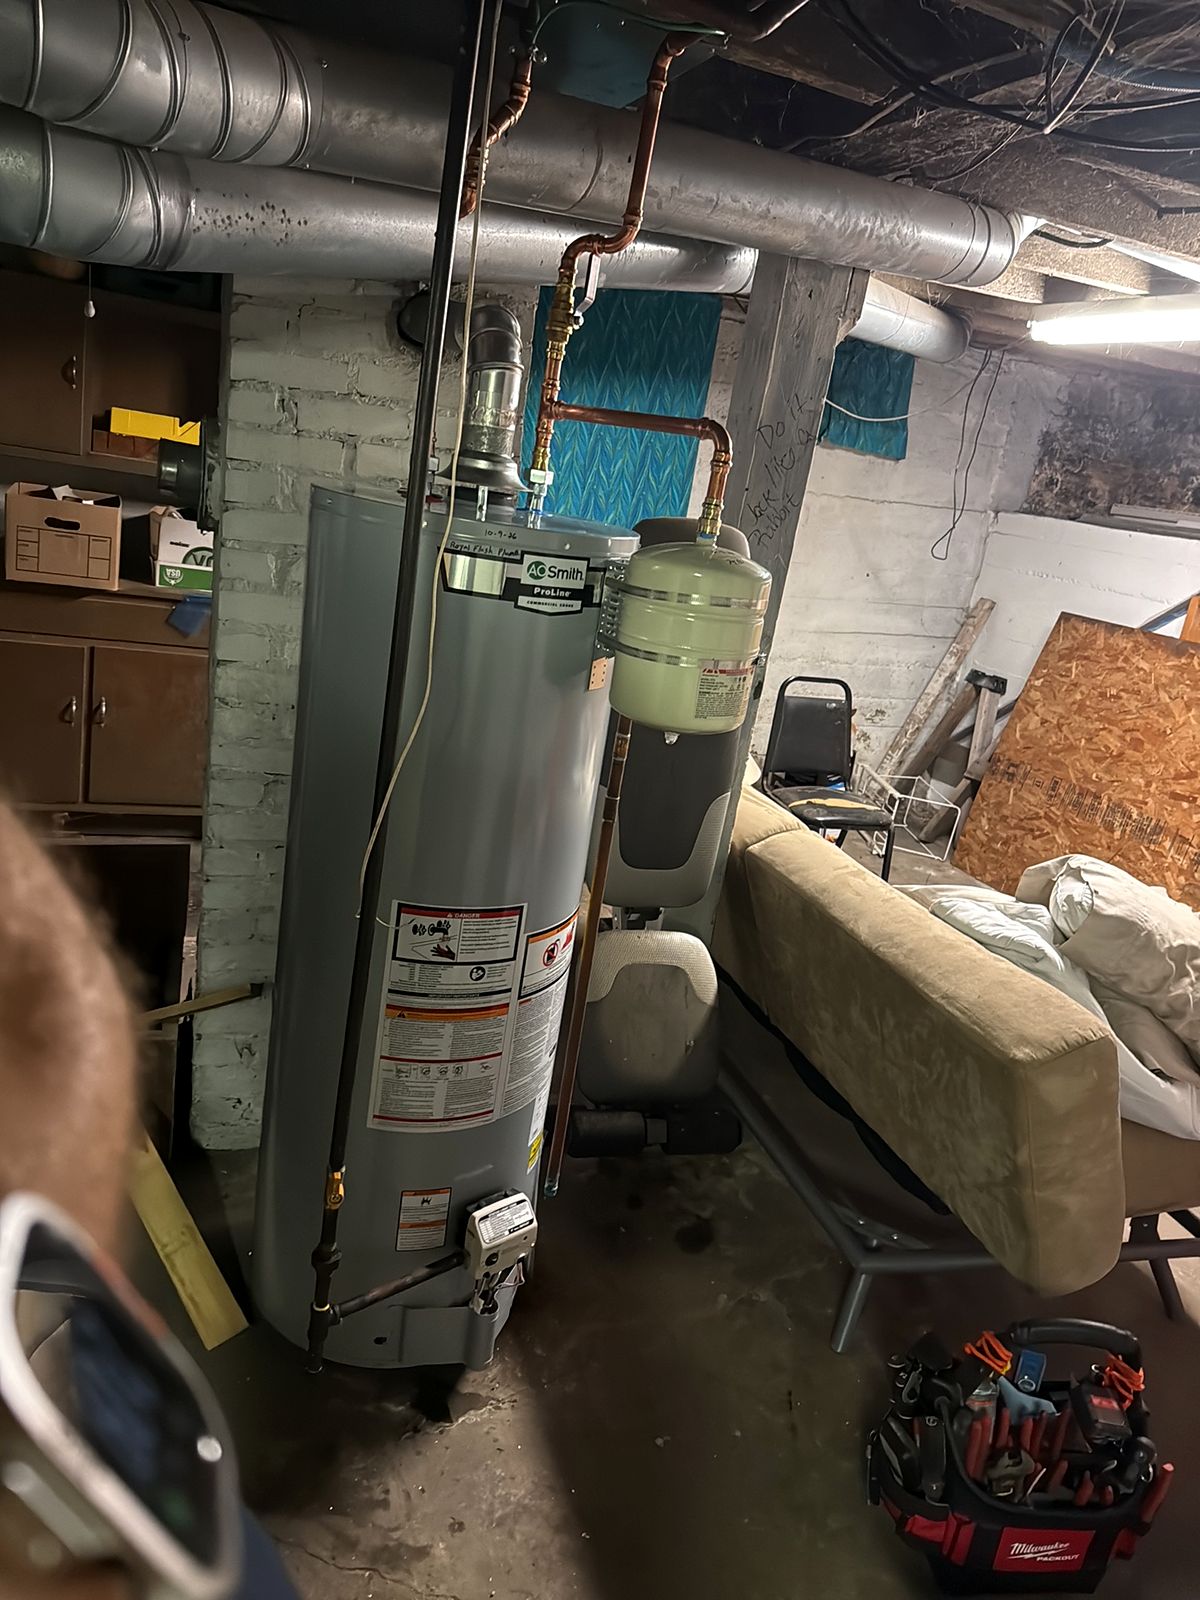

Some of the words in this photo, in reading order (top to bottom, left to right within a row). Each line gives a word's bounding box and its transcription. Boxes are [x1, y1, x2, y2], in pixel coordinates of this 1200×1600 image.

[757, 421, 785, 449] Do
[533, 587, 571, 597] ProLine
[1009, 1541, 1070, 1556] Milwaukee
[1036, 1553, 1080, 1562] PACKOUT
